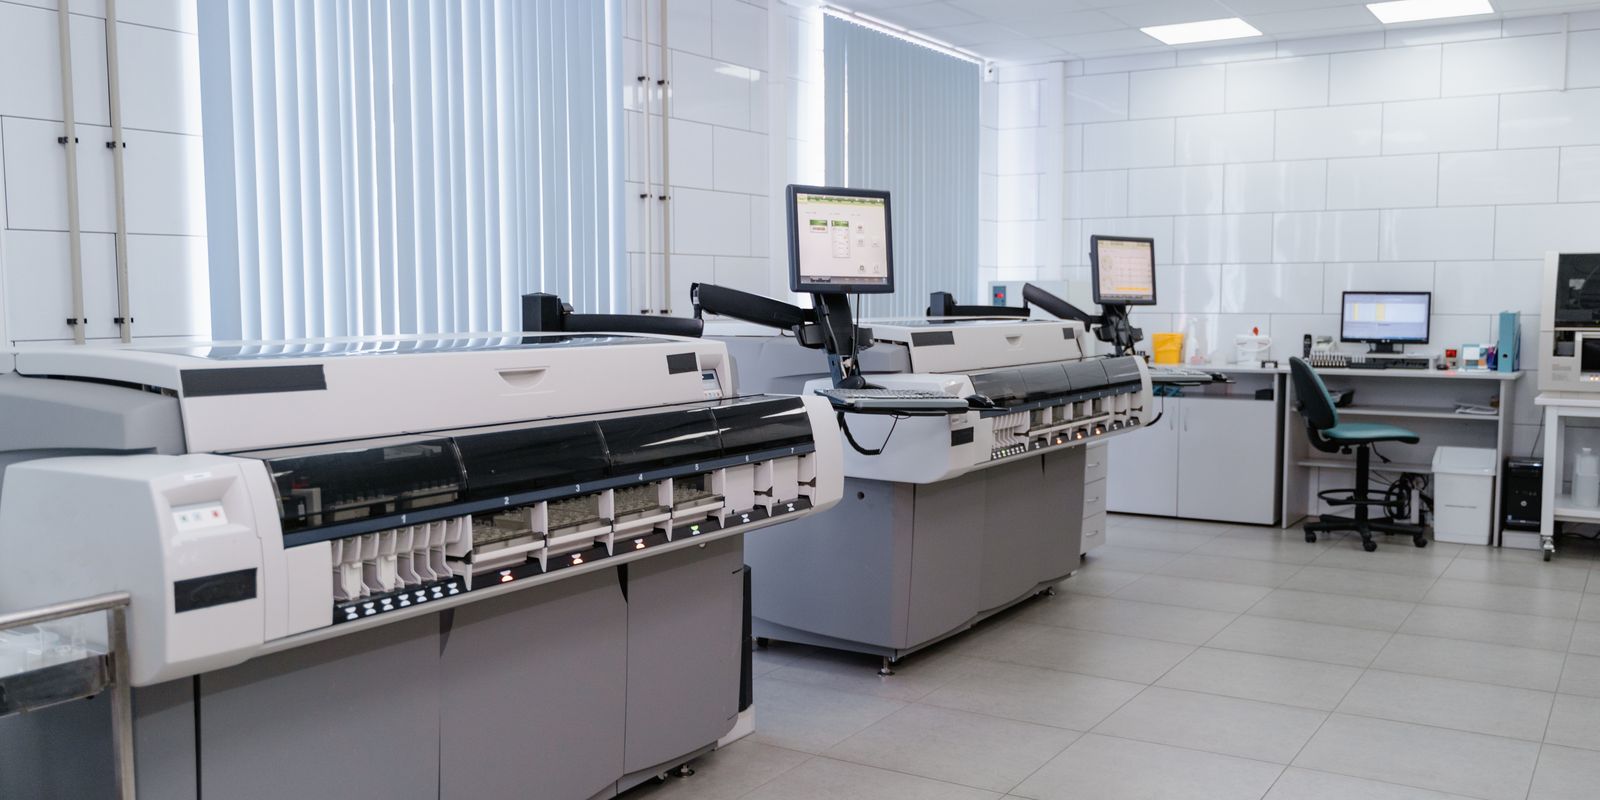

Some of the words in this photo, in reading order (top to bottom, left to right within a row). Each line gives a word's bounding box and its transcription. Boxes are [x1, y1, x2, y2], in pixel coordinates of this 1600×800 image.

[638, 473, 643, 481] 4
[575, 484, 581, 492] 3
[504, 496, 510, 505] 2
[401, 514, 407, 524] 1
